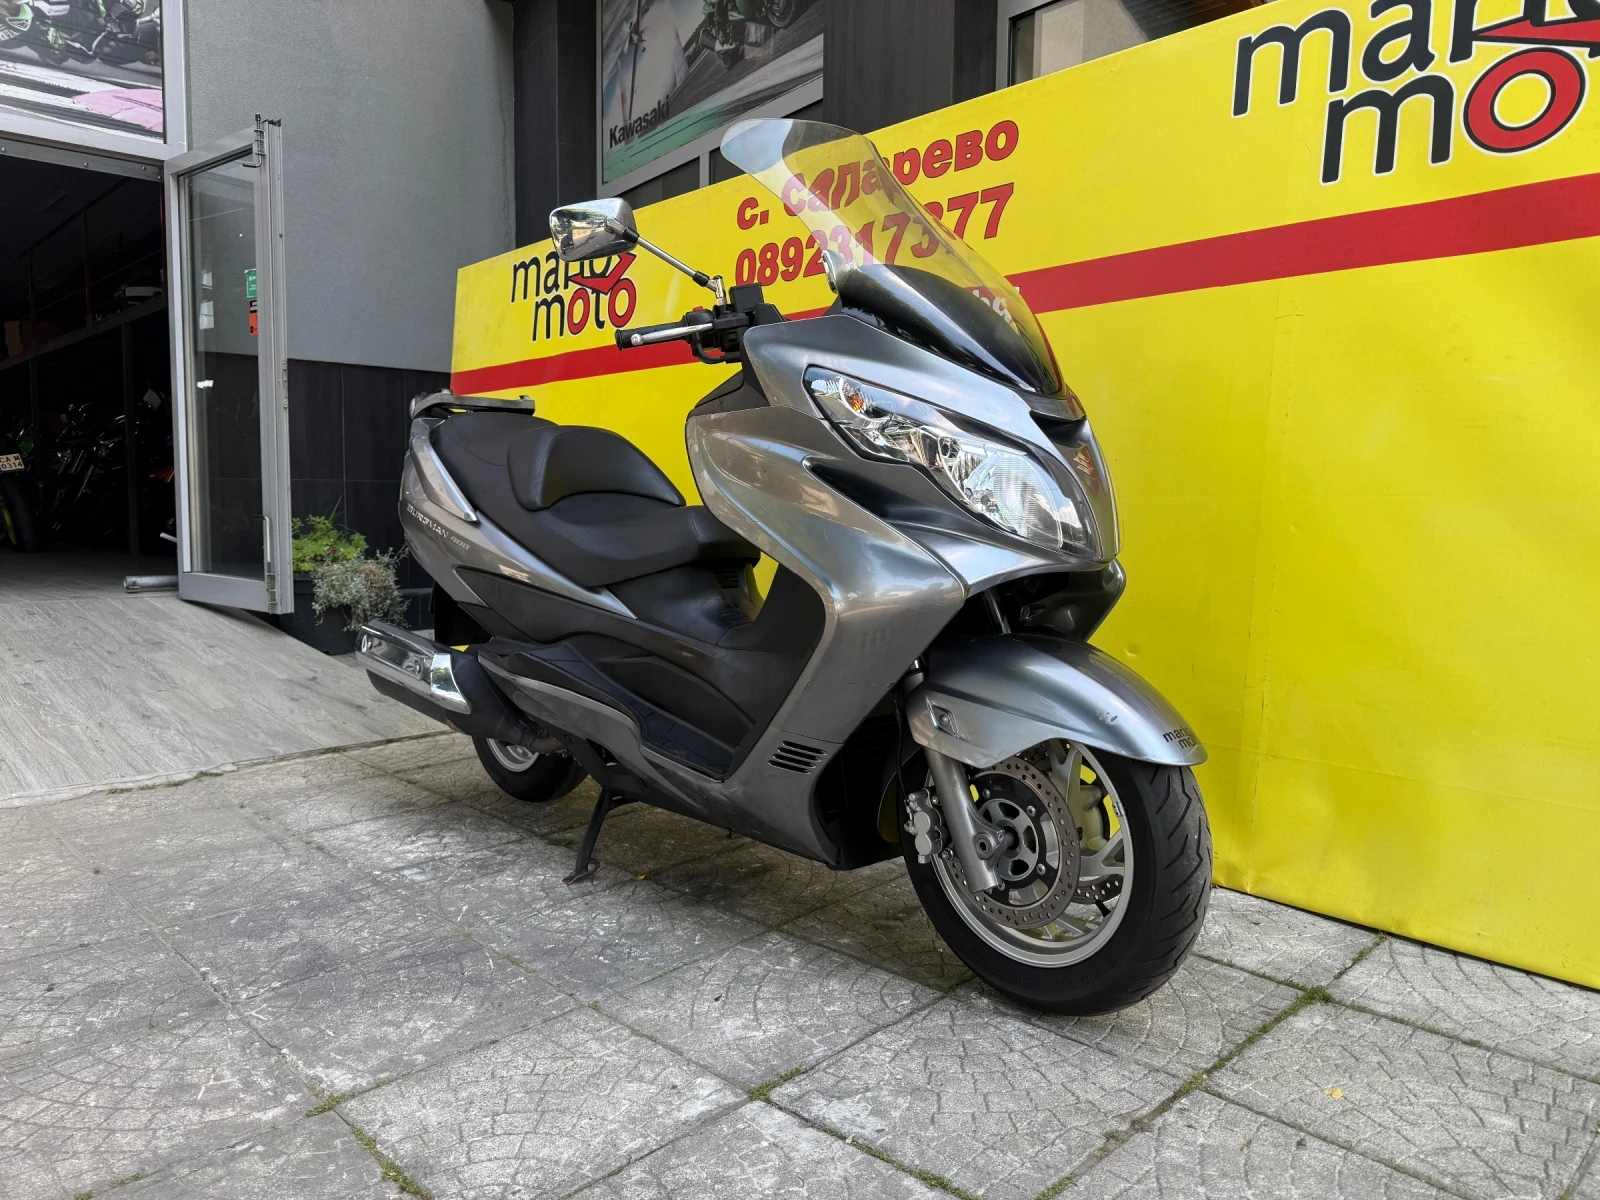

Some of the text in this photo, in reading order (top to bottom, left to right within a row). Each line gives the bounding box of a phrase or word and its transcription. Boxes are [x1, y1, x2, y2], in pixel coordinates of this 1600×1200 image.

[609, 95, 670, 148] Kawasaki
[532, 277, 637, 342] moto
[406, 503, 449, 539] BURGMAN
